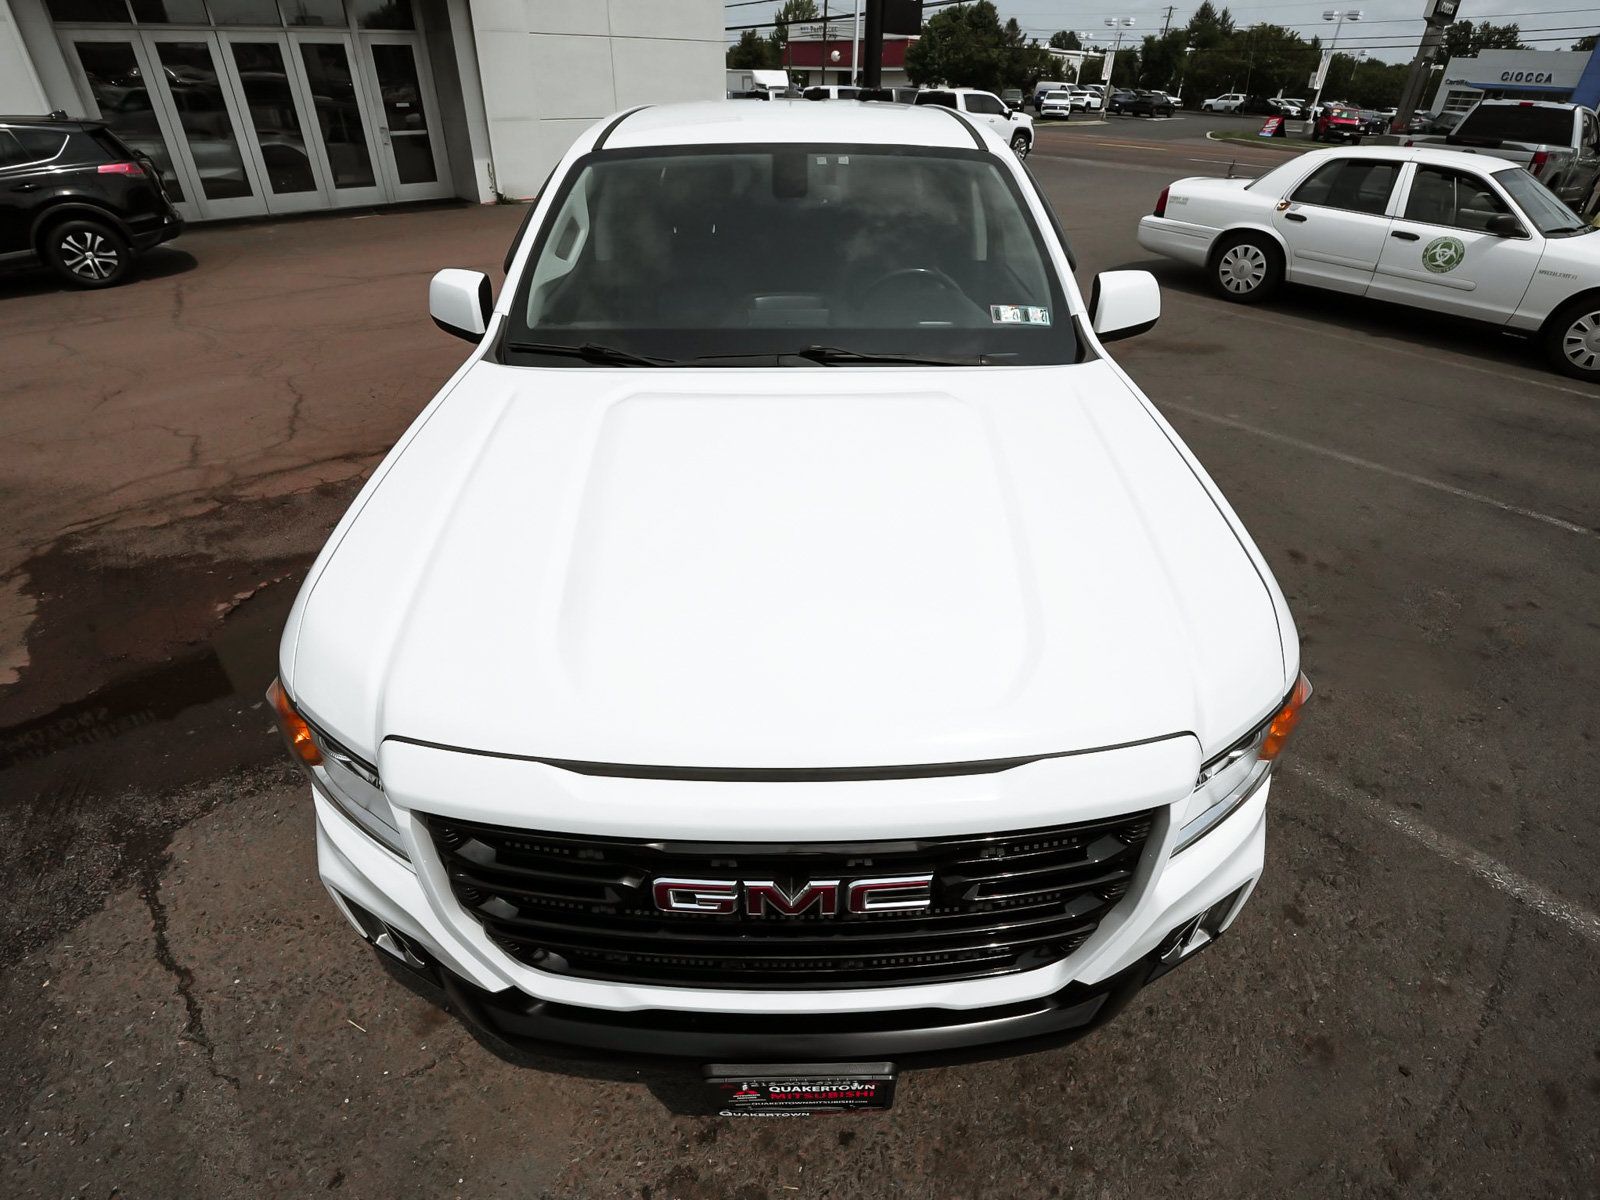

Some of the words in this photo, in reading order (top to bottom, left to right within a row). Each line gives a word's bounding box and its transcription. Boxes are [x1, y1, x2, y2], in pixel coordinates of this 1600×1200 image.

[1501, 71, 1553, 84] CIOCCA
[652, 872, 934, 916] GMC
[768, 1084, 876, 1092] QUAKERTOWN
[769, 1091, 875, 1099] MITSUBISHI
[718, 1110, 810, 1118] QUAKERTOWN
